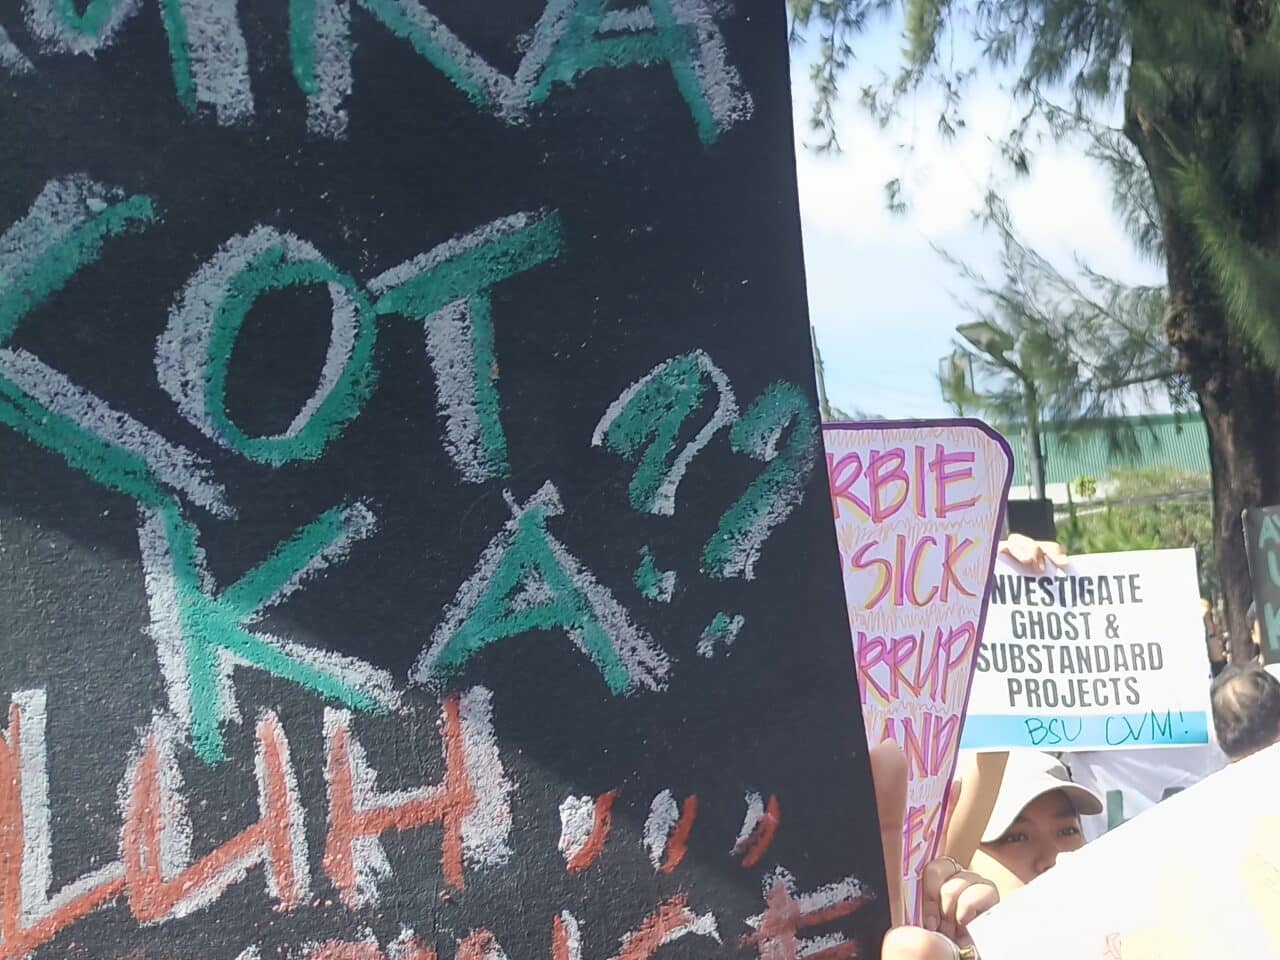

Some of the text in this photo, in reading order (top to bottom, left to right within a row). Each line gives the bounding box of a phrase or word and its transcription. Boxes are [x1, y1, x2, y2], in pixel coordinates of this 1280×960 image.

[851, 534, 977, 610] SICK
[992, 574, 1143, 607] NVESTIGATE
[1011, 610, 1121, 640] GHOST &
[977, 642, 1163, 675] SUBSTANDARD
[1007, 676, 1141, 708] PROJECTS
